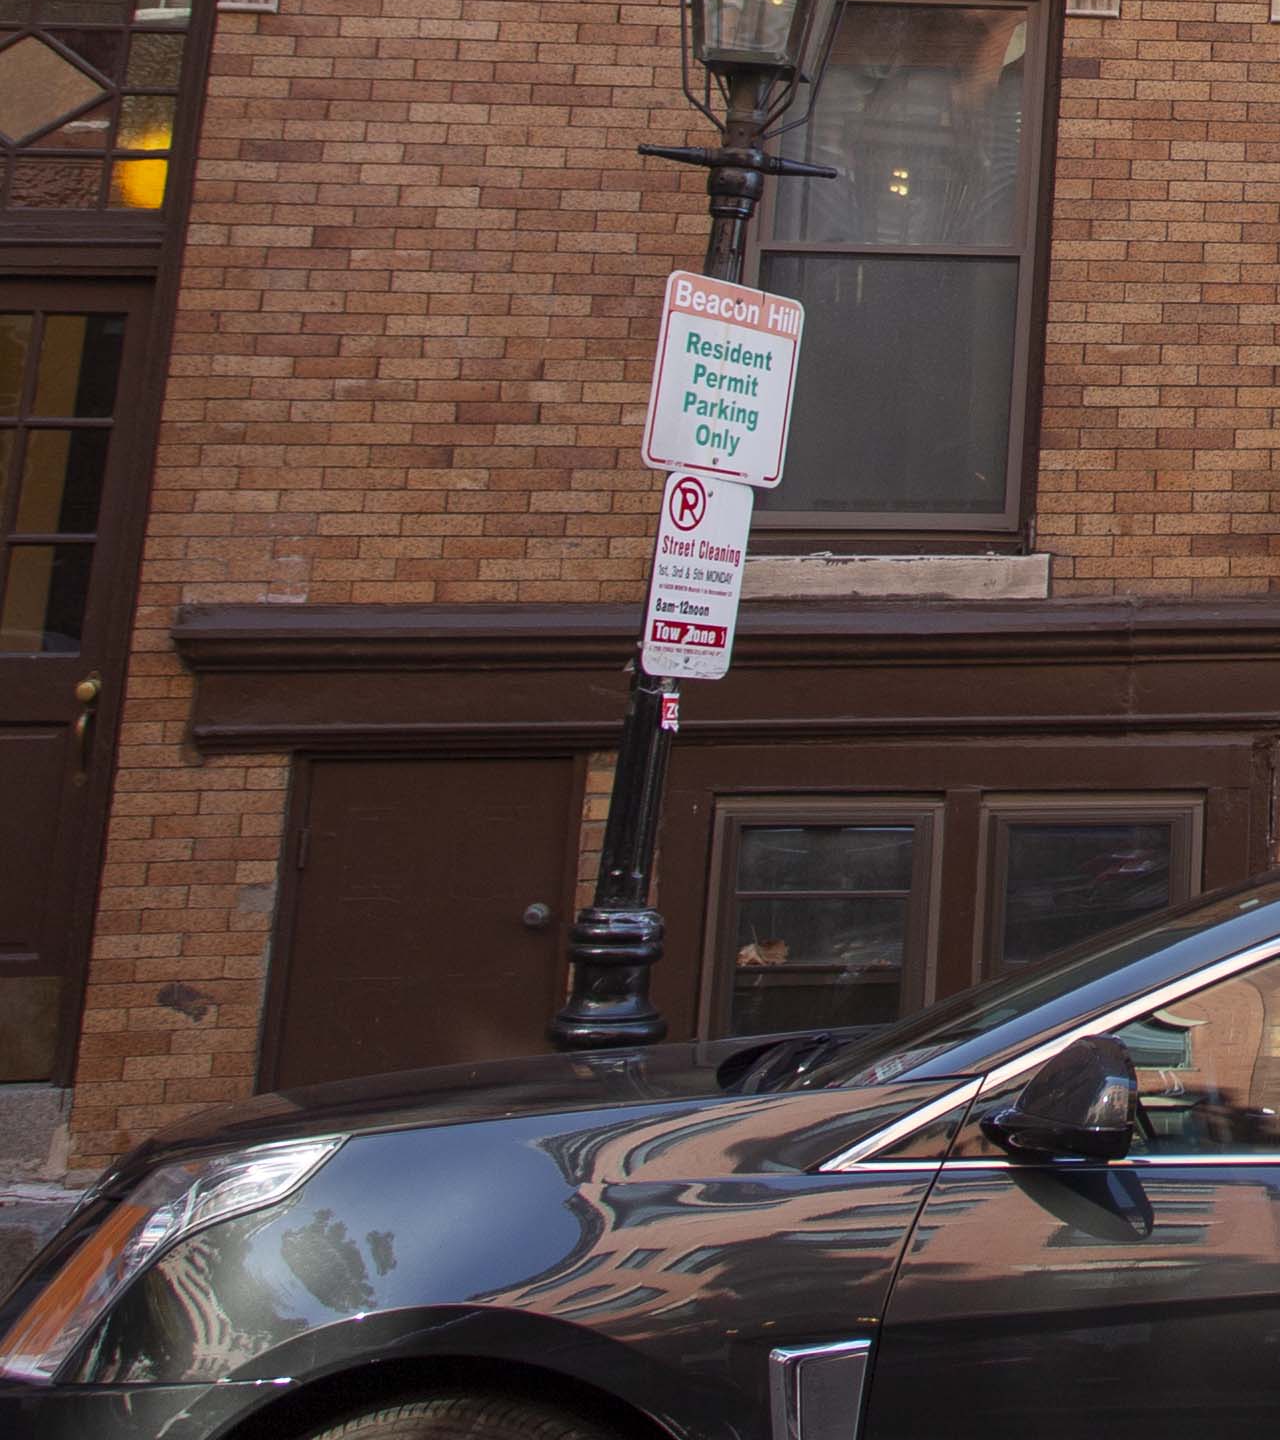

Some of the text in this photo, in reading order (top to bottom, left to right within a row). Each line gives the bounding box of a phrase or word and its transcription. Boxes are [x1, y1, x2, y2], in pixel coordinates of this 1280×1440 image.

[675, 280, 800, 335] Beacon Hill
[686, 331, 773, 371] Resident
[693, 363, 759, 397] Permit
[683, 391, 759, 432] Parking
[695, 424, 741, 457] Only
[662, 535, 741, 567] Street Cleaning
[671, 565, 683, 578] 3rd
[692, 568, 704, 580] 5th
[706, 570, 734, 585] MONDAY
[655, 598, 710, 617] 8am-12noon
[655, 622, 717, 645] Tow Zone
